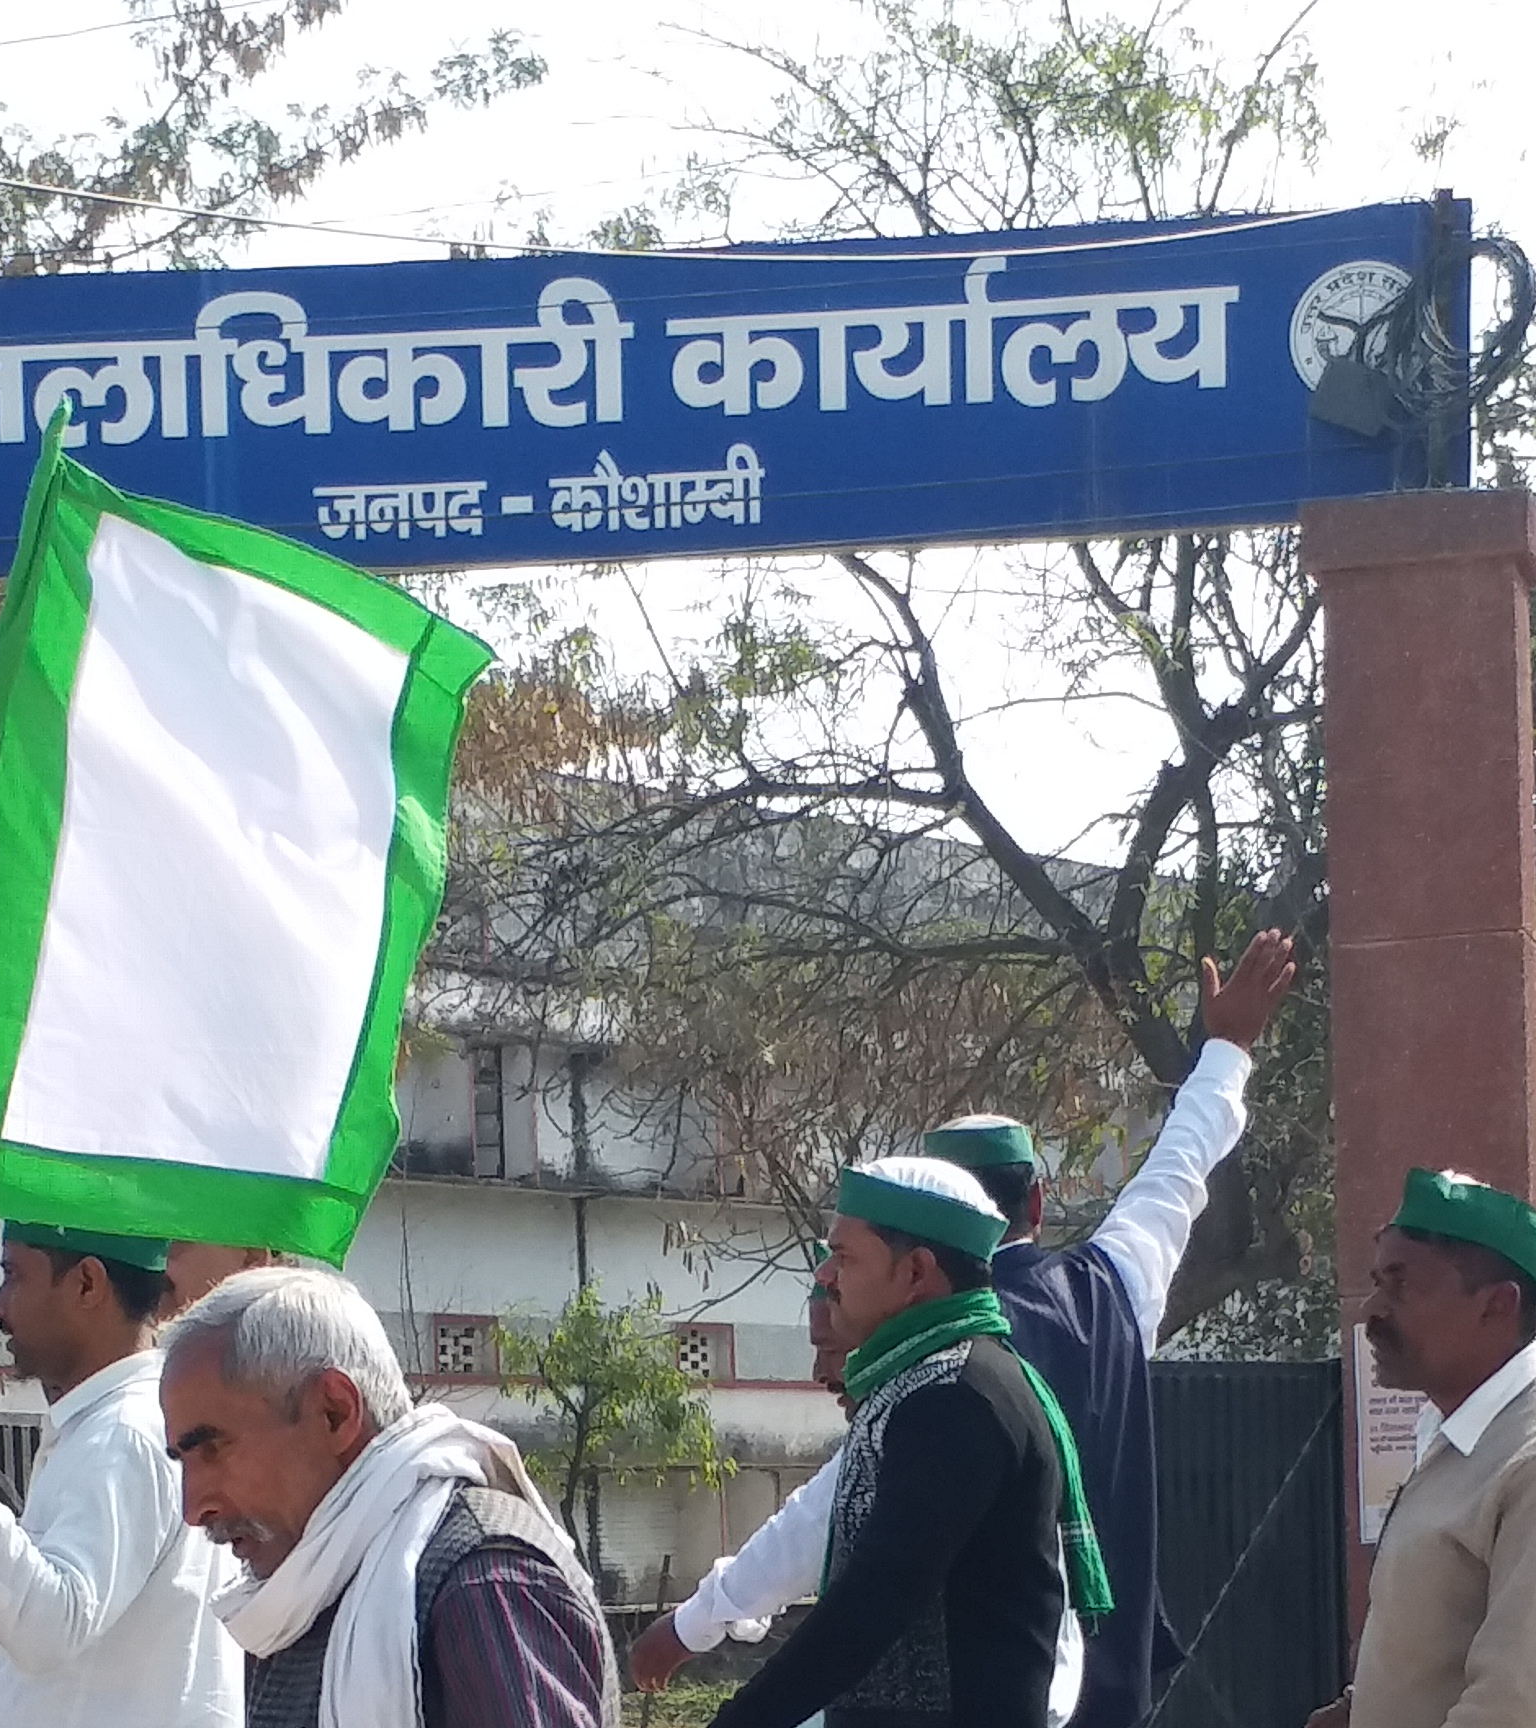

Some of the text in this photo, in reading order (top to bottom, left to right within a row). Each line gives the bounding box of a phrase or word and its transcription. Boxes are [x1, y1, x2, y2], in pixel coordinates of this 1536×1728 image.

[666, 256, 1241, 417] कार्यालय
[312, 481, 488, 540] जनपद
[548, 443, 766, 533] कौशाम्बी
